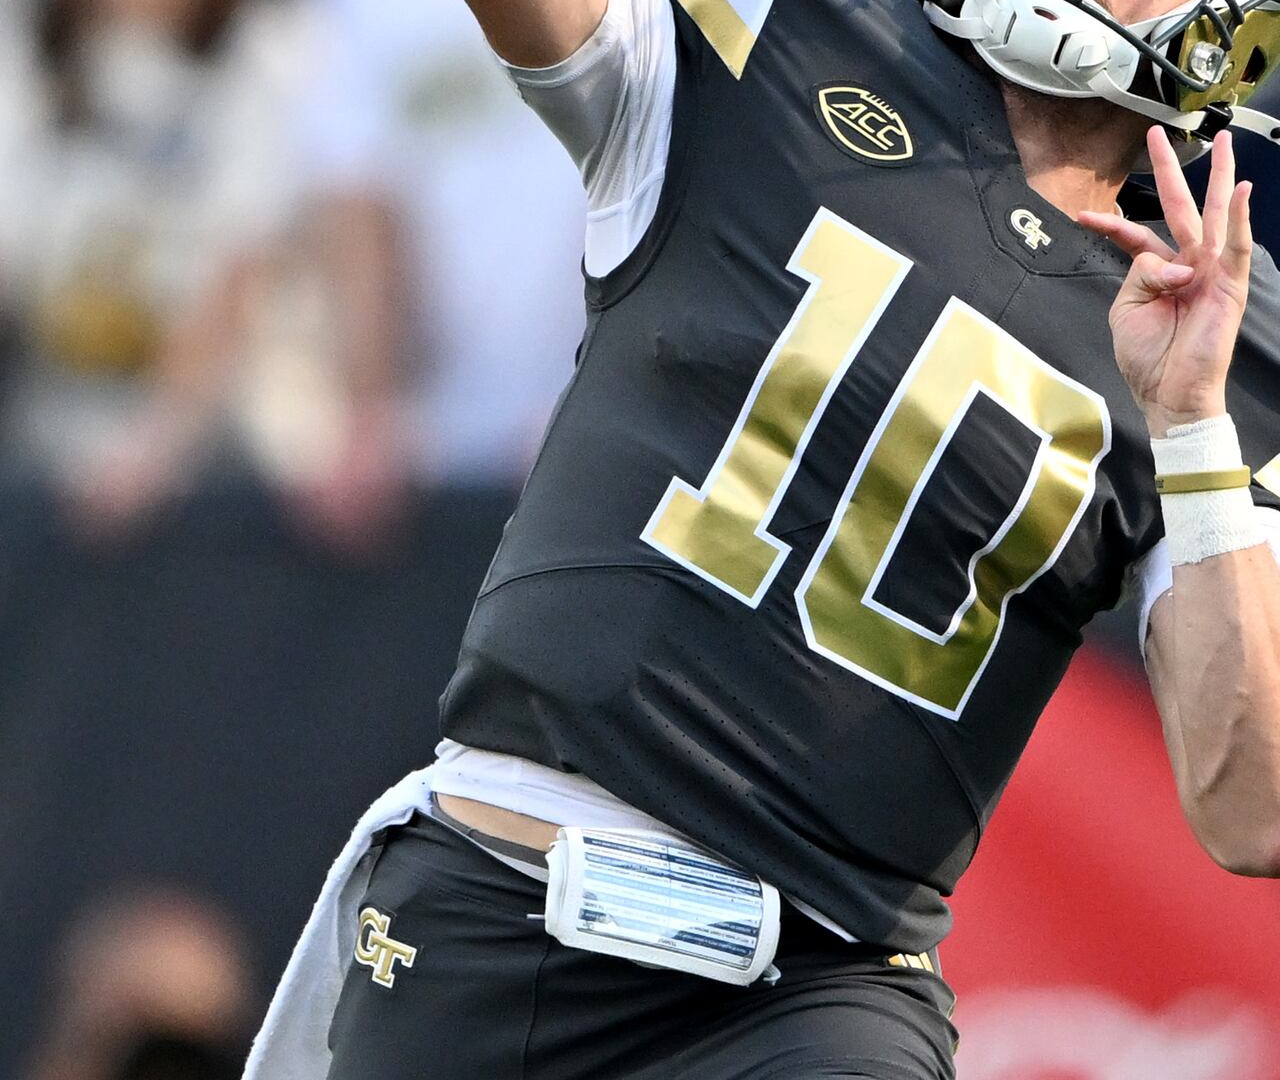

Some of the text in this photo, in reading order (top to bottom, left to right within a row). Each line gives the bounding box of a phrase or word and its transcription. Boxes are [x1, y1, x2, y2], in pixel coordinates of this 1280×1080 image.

[829, 103, 905, 148] ACC
[1010, 208, 1052, 250] GT
[639, 205, 1113, 721] 10
[354, 906, 418, 989] GT
